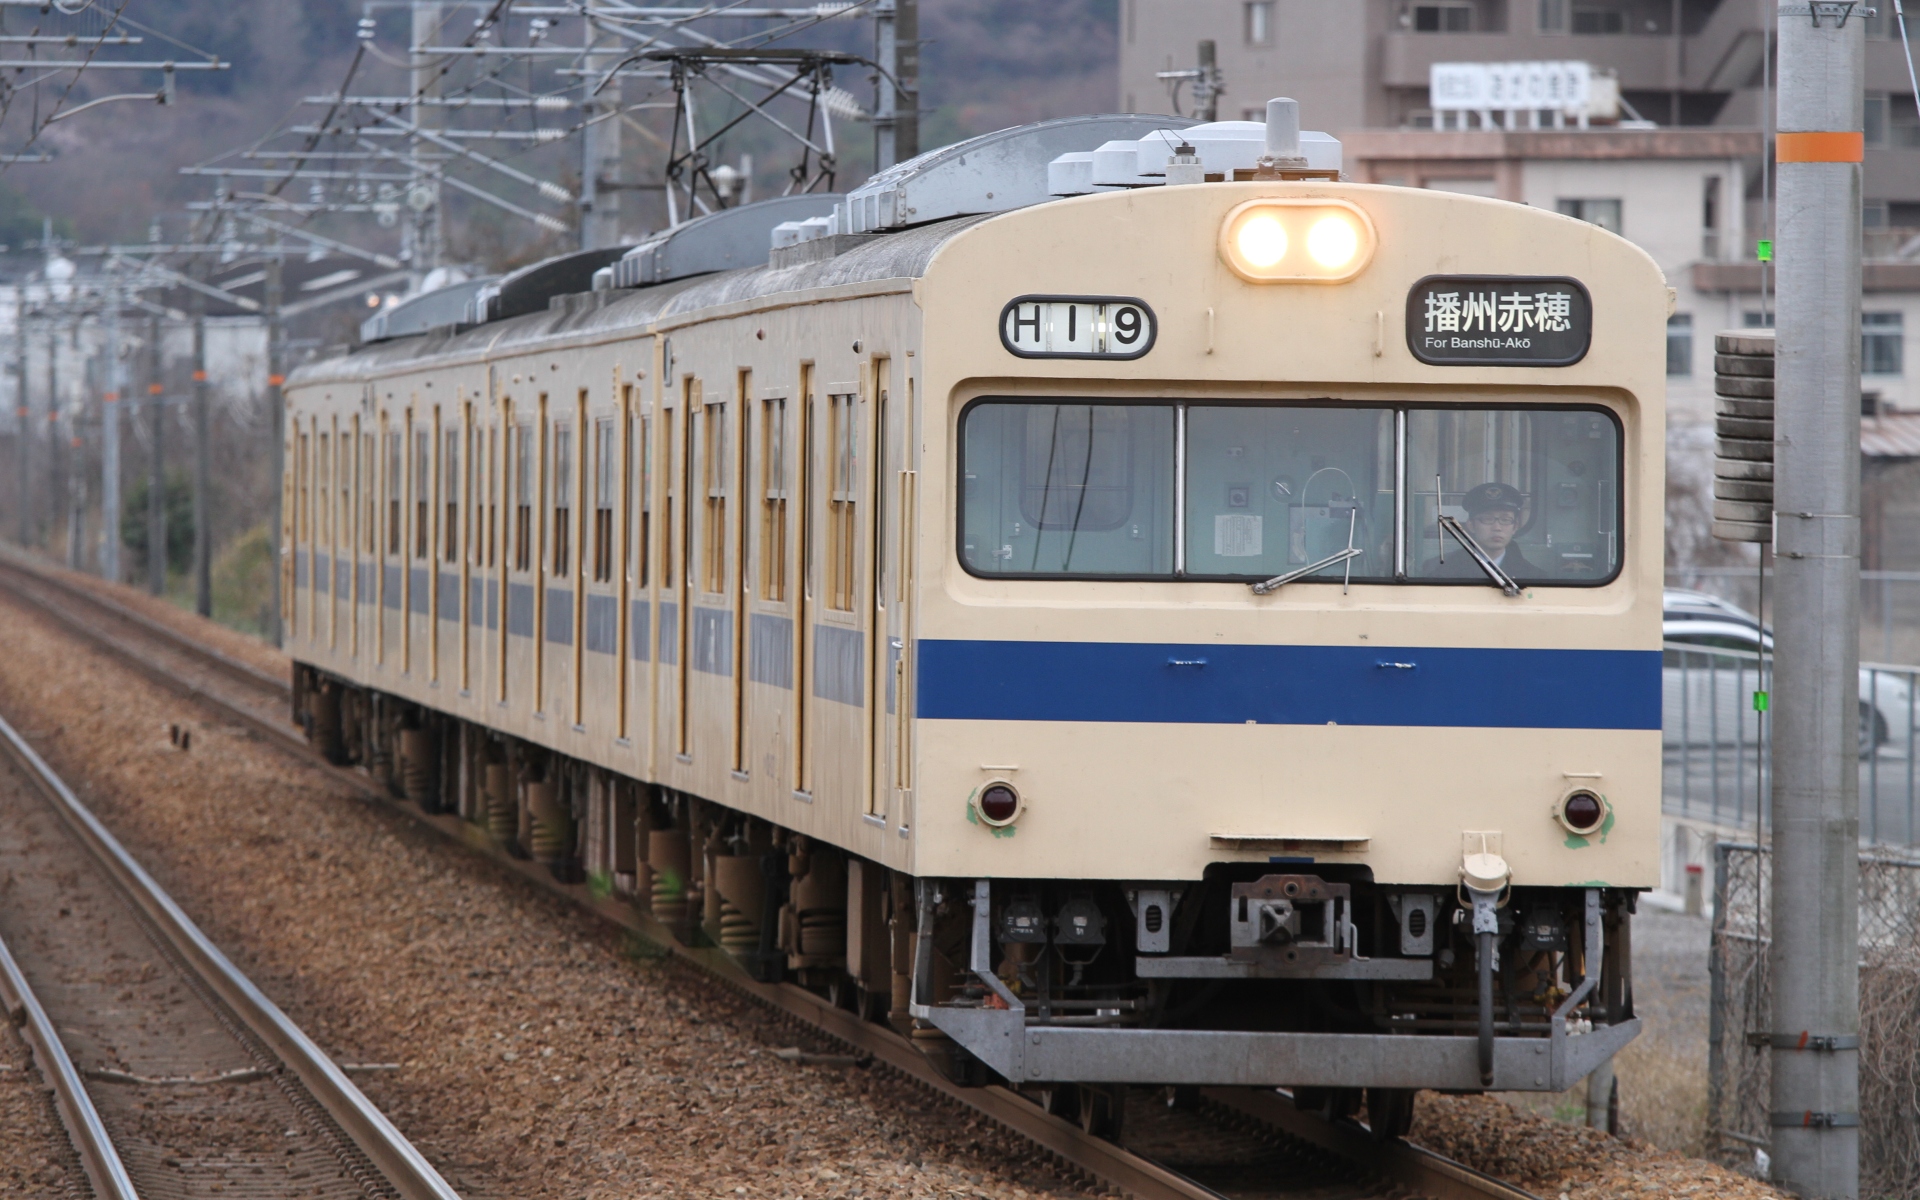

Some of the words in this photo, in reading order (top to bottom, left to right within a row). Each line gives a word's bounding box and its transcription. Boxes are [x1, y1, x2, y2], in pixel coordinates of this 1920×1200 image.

[1424, 291, 1572, 333] 播州赤穂
[1425, 337, 1448, 349] For
